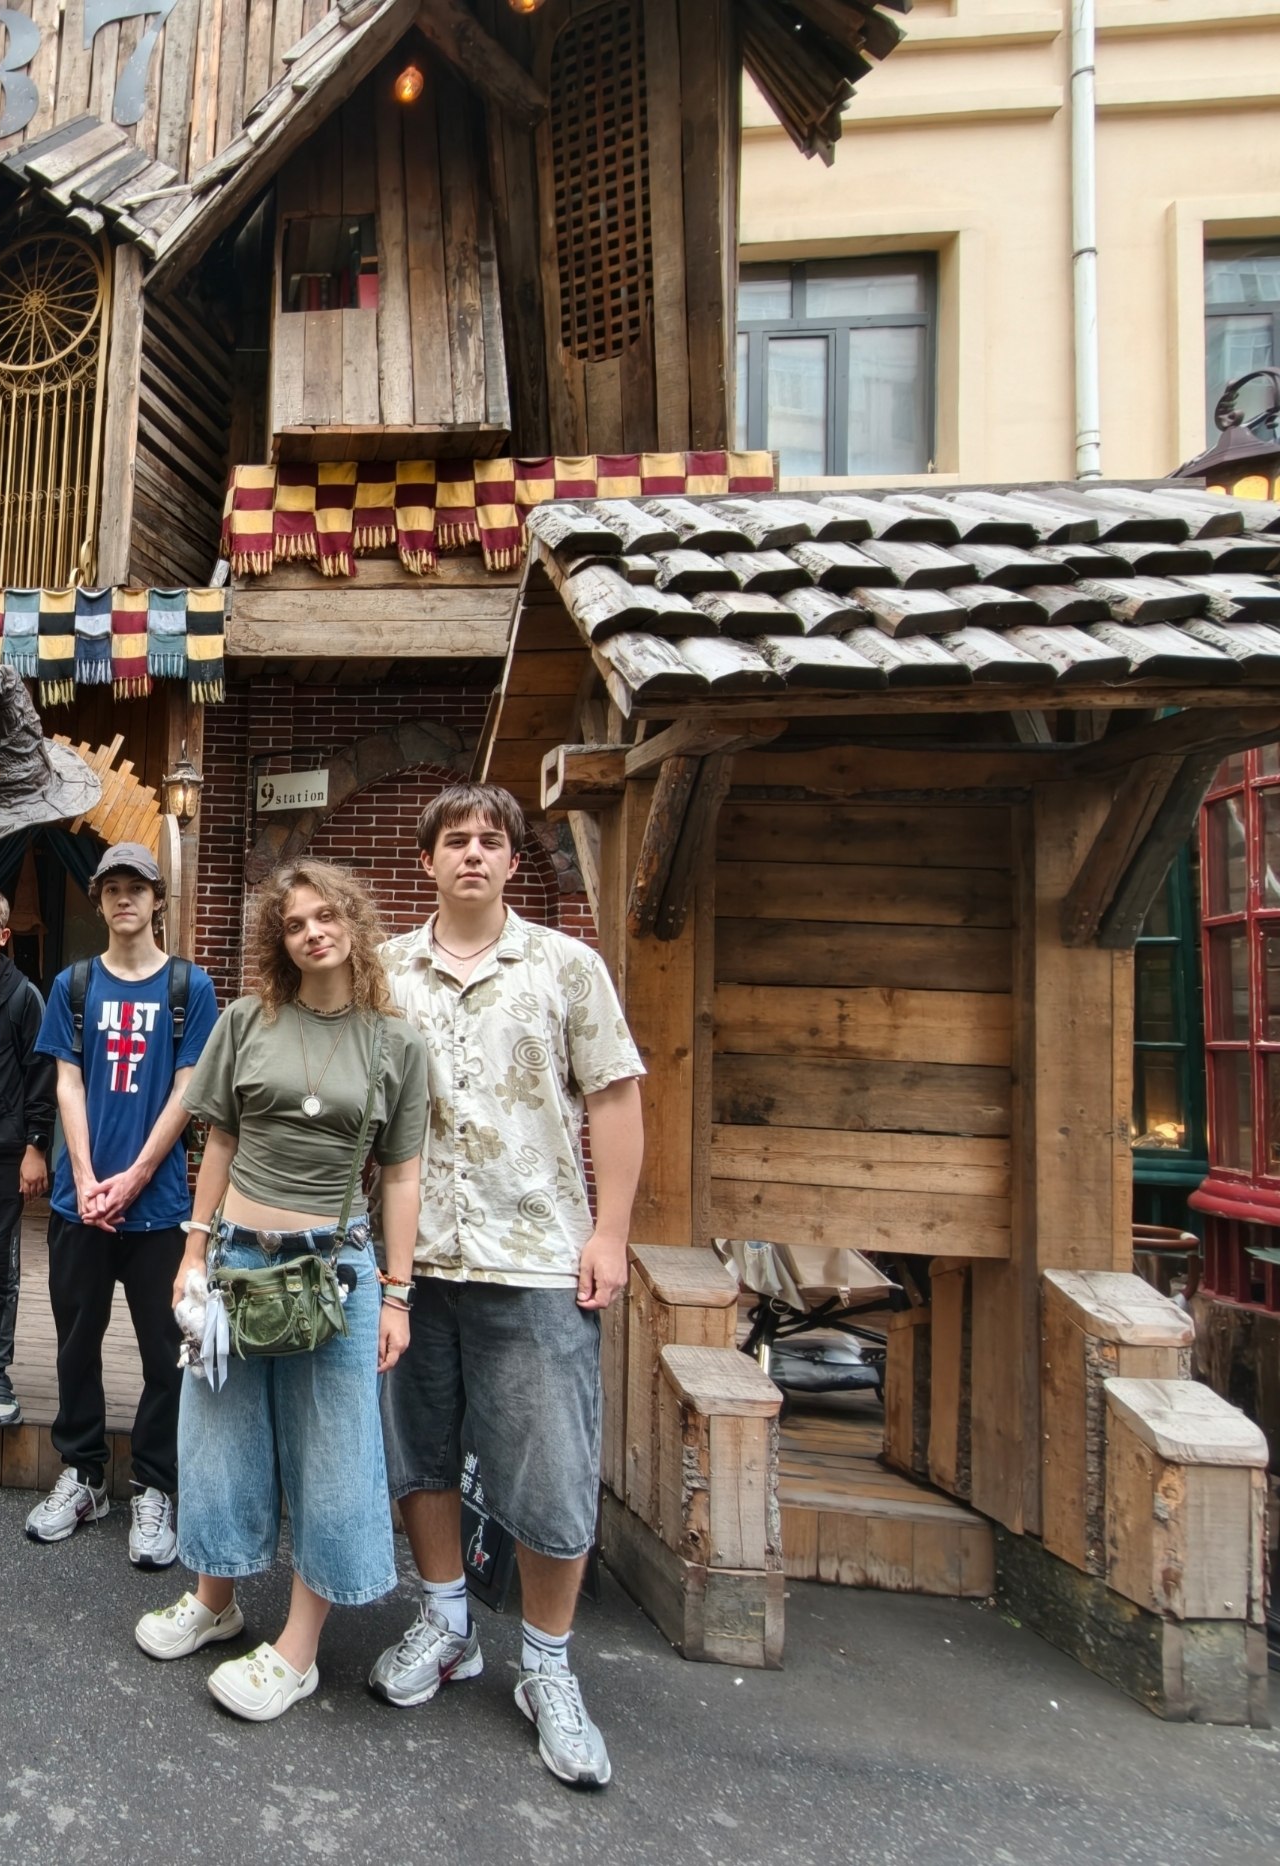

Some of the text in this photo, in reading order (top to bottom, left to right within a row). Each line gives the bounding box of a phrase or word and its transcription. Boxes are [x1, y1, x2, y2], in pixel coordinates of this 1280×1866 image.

[261, 782, 324, 808] 9 station
[98, 1001, 160, 1031] JUST
[106, 1030, 146, 1062] DO
